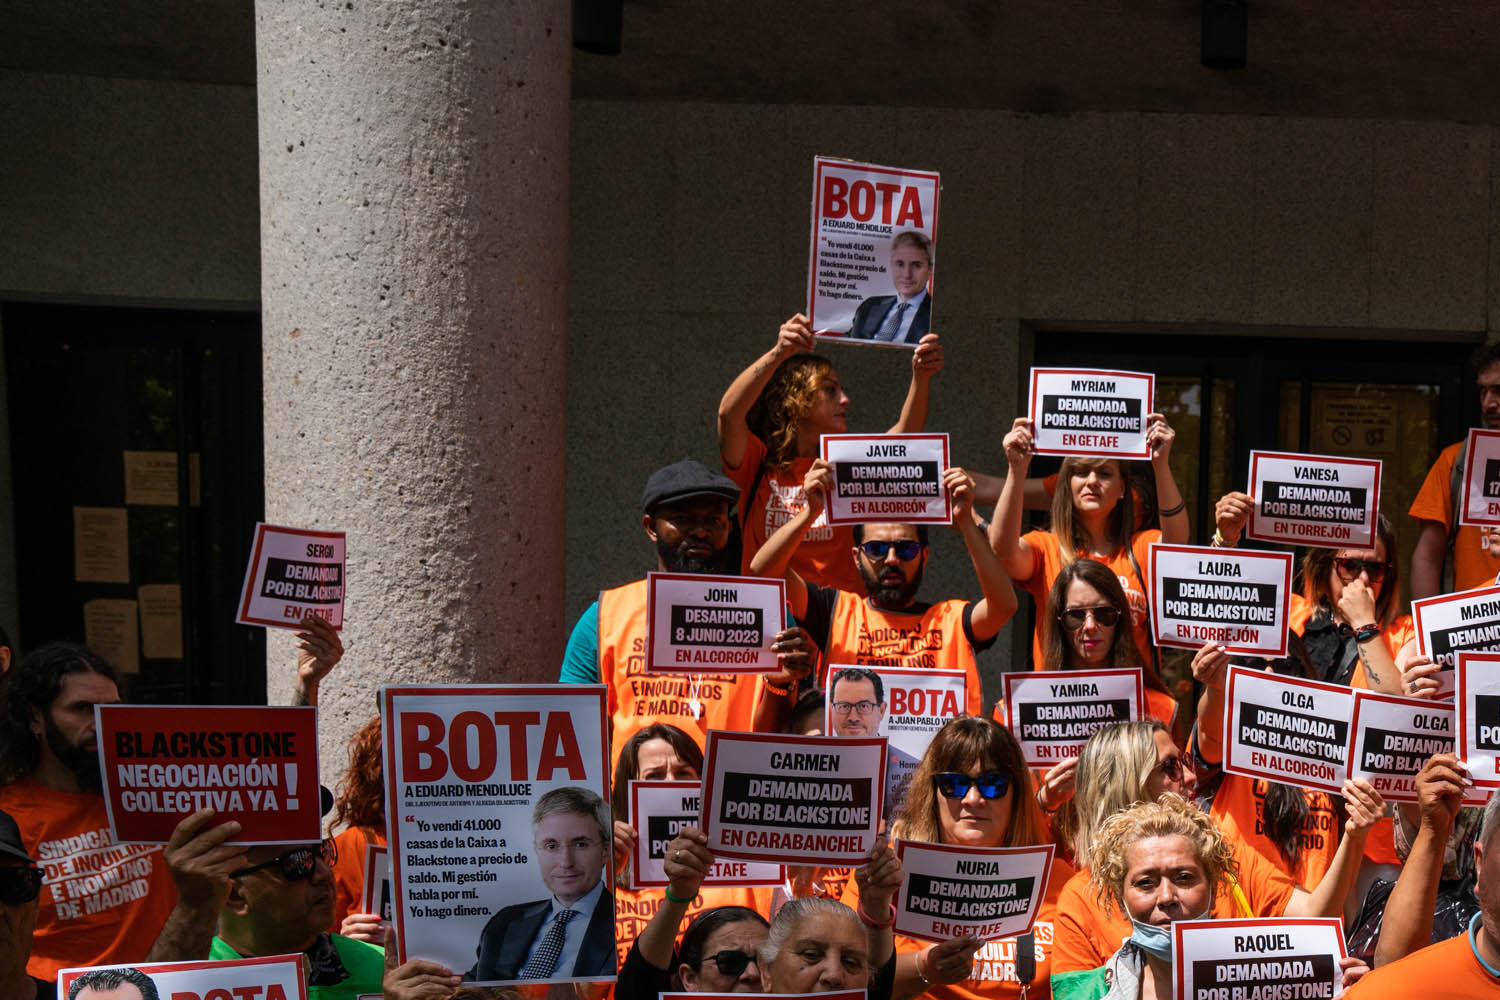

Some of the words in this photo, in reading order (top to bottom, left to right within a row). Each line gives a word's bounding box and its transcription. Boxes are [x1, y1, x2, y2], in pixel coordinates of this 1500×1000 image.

[823, 176, 924, 228] BOTA
[1071, 380, 1116, 393] MYRIAM
[1058, 398, 1127, 414] DEMANDADA
[1044, 414, 1070, 426] POR
[1071, 414, 1139, 430] BLACKSTONE
[1063, 434, 1076, 446] EN
[1080, 434, 1119, 448] GETAFE
[866, 445, 906, 458] JAVIER
[852, 466, 923, 479] DEMANDADO
[1294, 466, 1339, 482] VANESA
[1279, 486, 1351, 504] DEMANDADA
[1489, 482, 1500, 495] 17
[851, 502, 866, 513] EN
[868, 500, 926, 513] ALCORCÓN
[1274, 522, 1289, 533] EN
[1290, 522, 1350, 539] TORREJÓN
[1198, 561, 1241, 577] LAURA
[704, 589, 737, 602] JOHN
[1179, 583, 1259, 602] DEMANDADA
[685, 609, 755, 625] DESAHUCIO
[1177, 625, 1191, 638] EN
[1192, 626, 1258, 643] TORREJÓN
[676, 649, 694, 662] EN
[694, 649, 758, 663] ALCORCÓN
[1050, 684, 1099, 697] YAMIRA
[890, 688, 959, 716] BOTA
[1282, 691, 1314, 710] OLGA
[1037, 704, 1114, 720] DEMANDADA
[1257, 710, 1336, 740] DEMANDADA
[115, 732, 296, 758] BLACKSTONE
[400, 711, 587, 783] BOTA
[770, 752, 840, 772] CARMEN
[1252, 751, 1267, 768] EN
[1269, 756, 1335, 781] ALCORCÓN
[117, 758, 277, 787] NEGOCIACIÓN
[404, 785, 415, 798] A
[415, 784, 465, 797] EDUARD
[466, 784, 532, 797] MENDILUCE
[748, 780, 853, 801] DEMANDADA
[121, 789, 242, 813] COLECTIVA
[725, 801, 759, 819] POR
[760, 804, 869, 825] BLACKSTONE
[721, 829, 751, 847] EN
[752, 831, 865, 853] CARABANCHEL
[44, 860, 71, 880] DE
[956, 860, 999, 876] NURIA
[408, 871, 440, 884] saldo.
[442, 870, 455, 882] Mi
[456, 870, 497, 886] gestión
[50, 883, 65, 902] E
[928, 880, 1017, 897] DEMANDADA
[56, 900, 82, 920] DE
[84, 879, 149, 914] MADRID
[1235, 934, 1294, 953] RAQUEL
[1216, 961, 1314, 983] DEMANDADA
